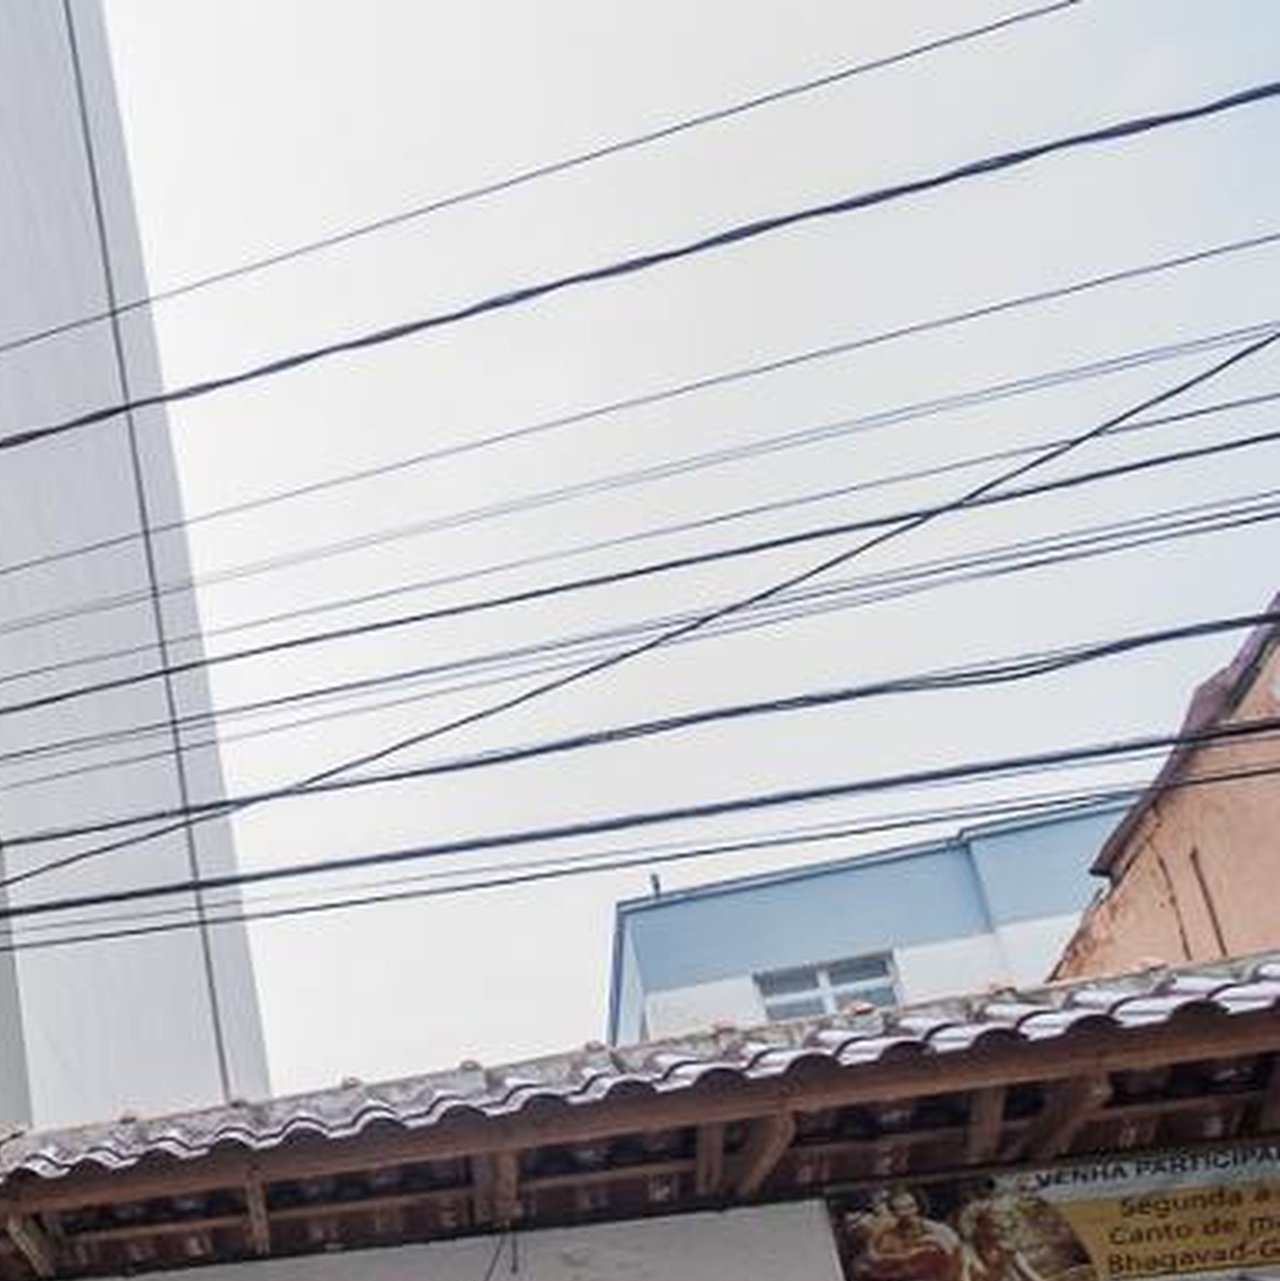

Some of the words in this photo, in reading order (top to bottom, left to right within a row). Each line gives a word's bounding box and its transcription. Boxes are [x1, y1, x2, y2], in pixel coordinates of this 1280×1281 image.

[1035, 1164, 1128, 1188] VENHA
[1136, 1147, 1280, 1177] PARTICIPA
[1203, 1216, 1237, 1236] de
